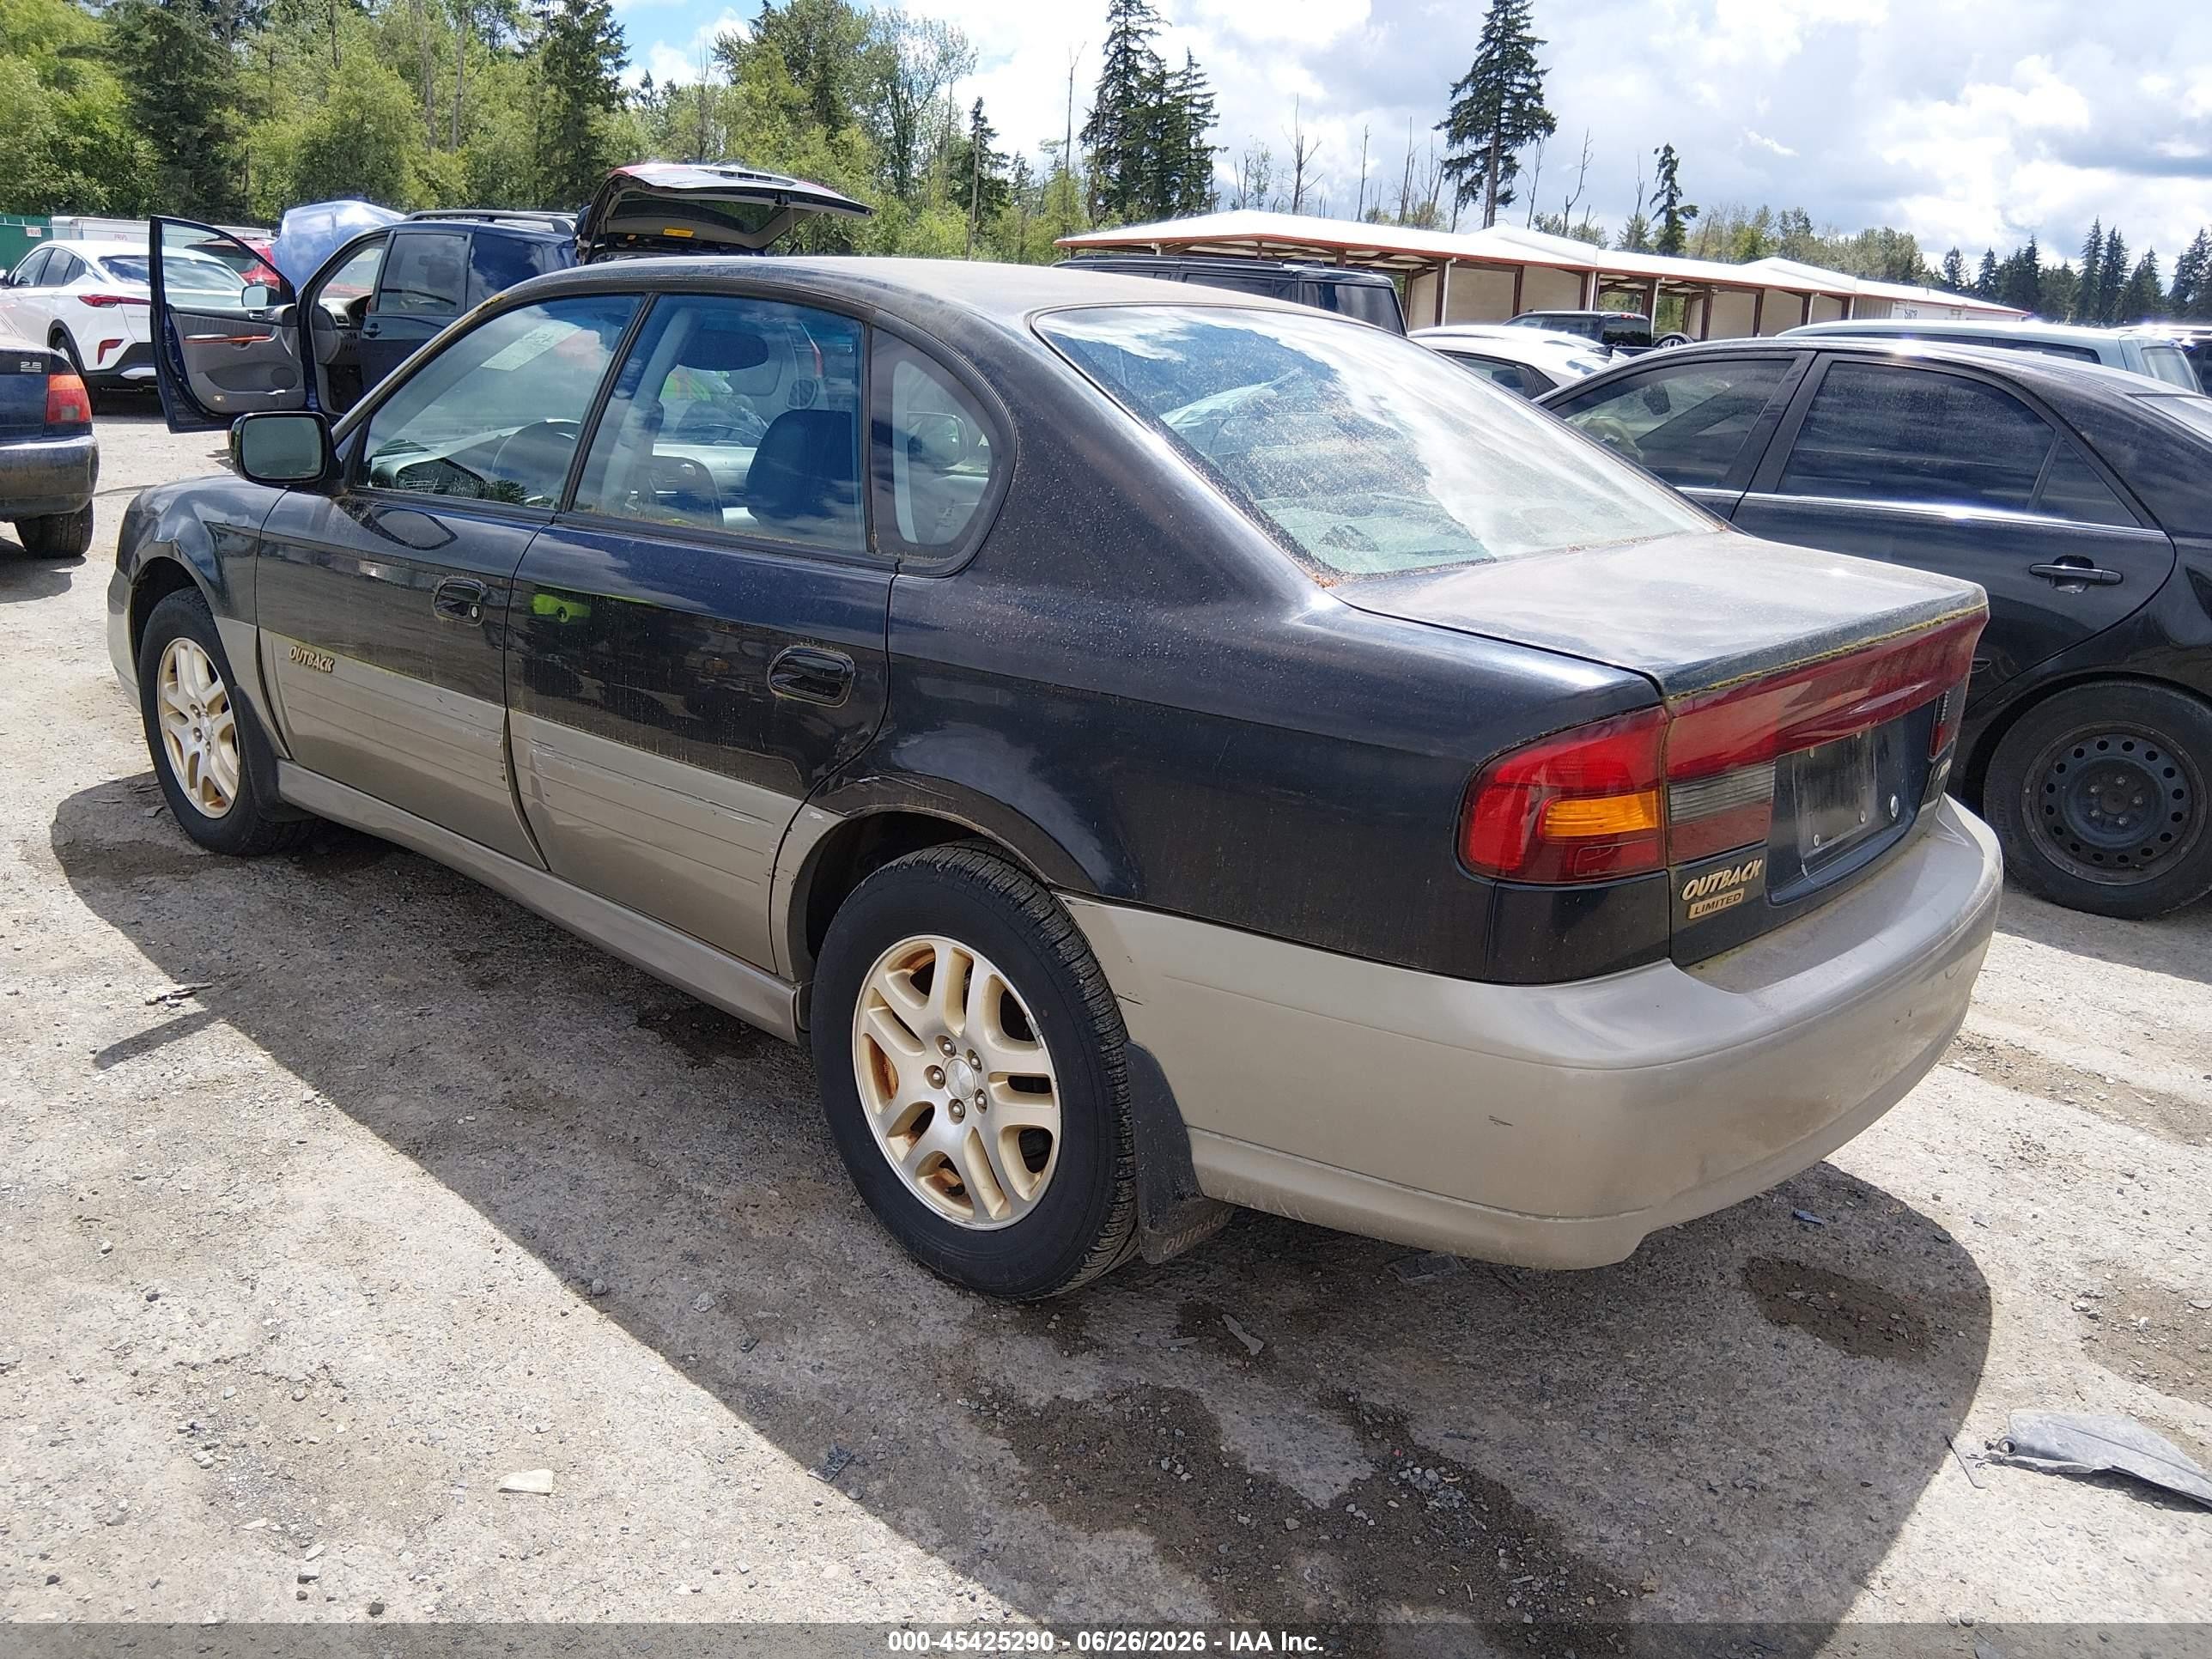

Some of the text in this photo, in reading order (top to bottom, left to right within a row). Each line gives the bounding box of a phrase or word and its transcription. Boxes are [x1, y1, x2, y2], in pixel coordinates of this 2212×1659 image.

[289, 645, 336, 673] OUTBACK
[1681, 859, 1763, 901] OUTBACK
[1694, 893, 1741, 915] LIMITED
